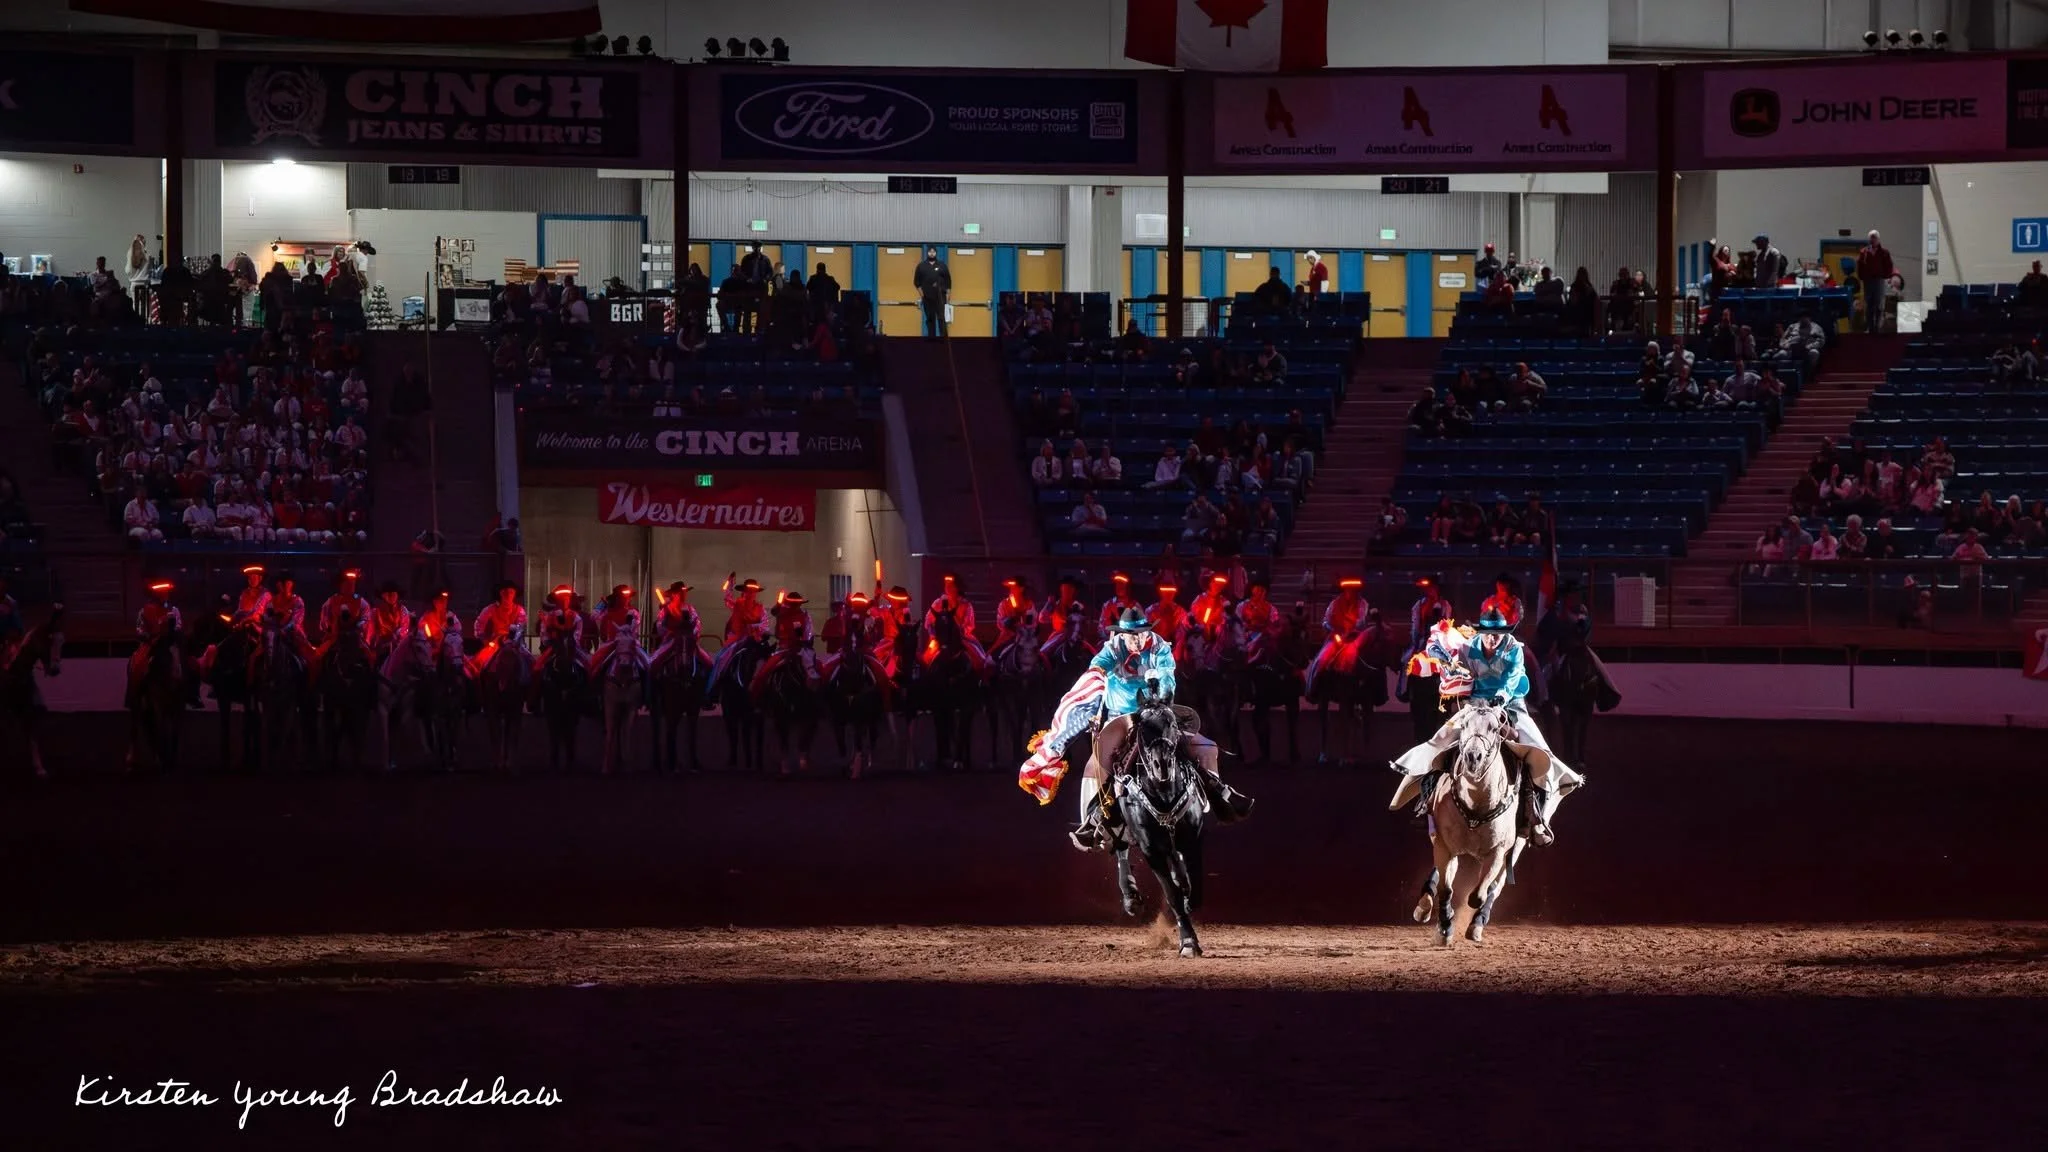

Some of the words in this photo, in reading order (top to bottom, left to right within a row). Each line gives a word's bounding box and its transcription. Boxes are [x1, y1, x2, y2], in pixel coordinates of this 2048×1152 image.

[345, 69, 605, 119] CINCH
[773, 91, 896, 140] Ford
[948, 107, 999, 119] PROUD
[1003, 108, 1080, 121] SPONSORS
[1792, 100, 1872, 124] JOHN
[1880, 97, 1978, 120] DEERE
[347, 119, 446, 144] JEANS
[453, 121, 479, 142] &
[485, 123, 603, 145] SHIRTS
[1229, 144, 1262, 156] Ames
[1263, 143, 1337, 156] Construction
[1365, 143, 1398, 155] Ames
[1502, 141, 1535, 153] Ames
[1537, 140, 1612, 153] Construction
[610, 303, 644, 322] BGR
[535, 431, 602, 449] Welcome
[606, 432, 621, 449] to
[625, 432, 649, 449] the
[655, 430, 800, 456] CINCH
[806, 436, 863, 451] ARENA
[607, 481, 806, 527] Westernaires
